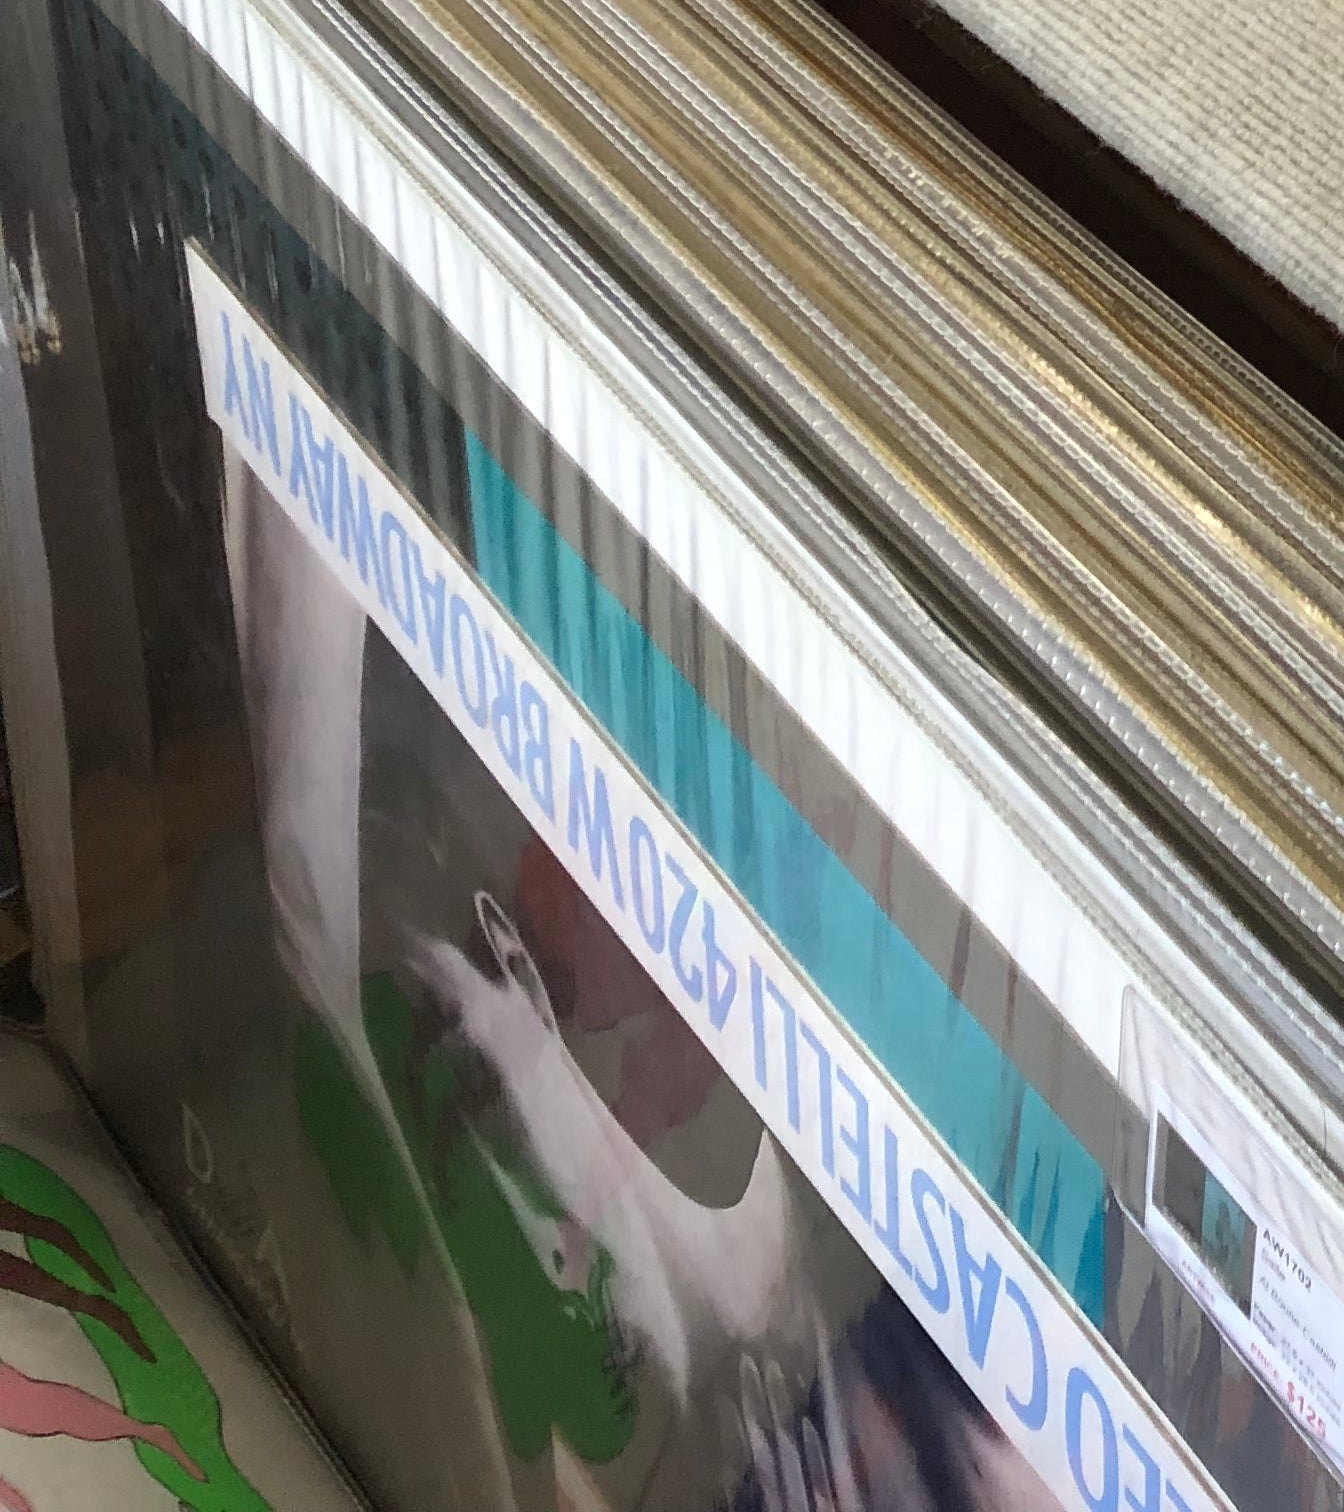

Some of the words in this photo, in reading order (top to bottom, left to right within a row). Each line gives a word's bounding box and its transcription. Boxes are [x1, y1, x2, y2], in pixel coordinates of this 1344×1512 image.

[221, 310, 281, 478] NY
[288, 393, 553, 816] BROADWAY
[567, 736, 624, 908] W
[627, 815, 738, 1033] 420
[750, 960, 1052, 1433] CASTELLI
[1263, 1228, 1312, 1293] AW1702
[1064, 1365, 1194, 1512] EO
